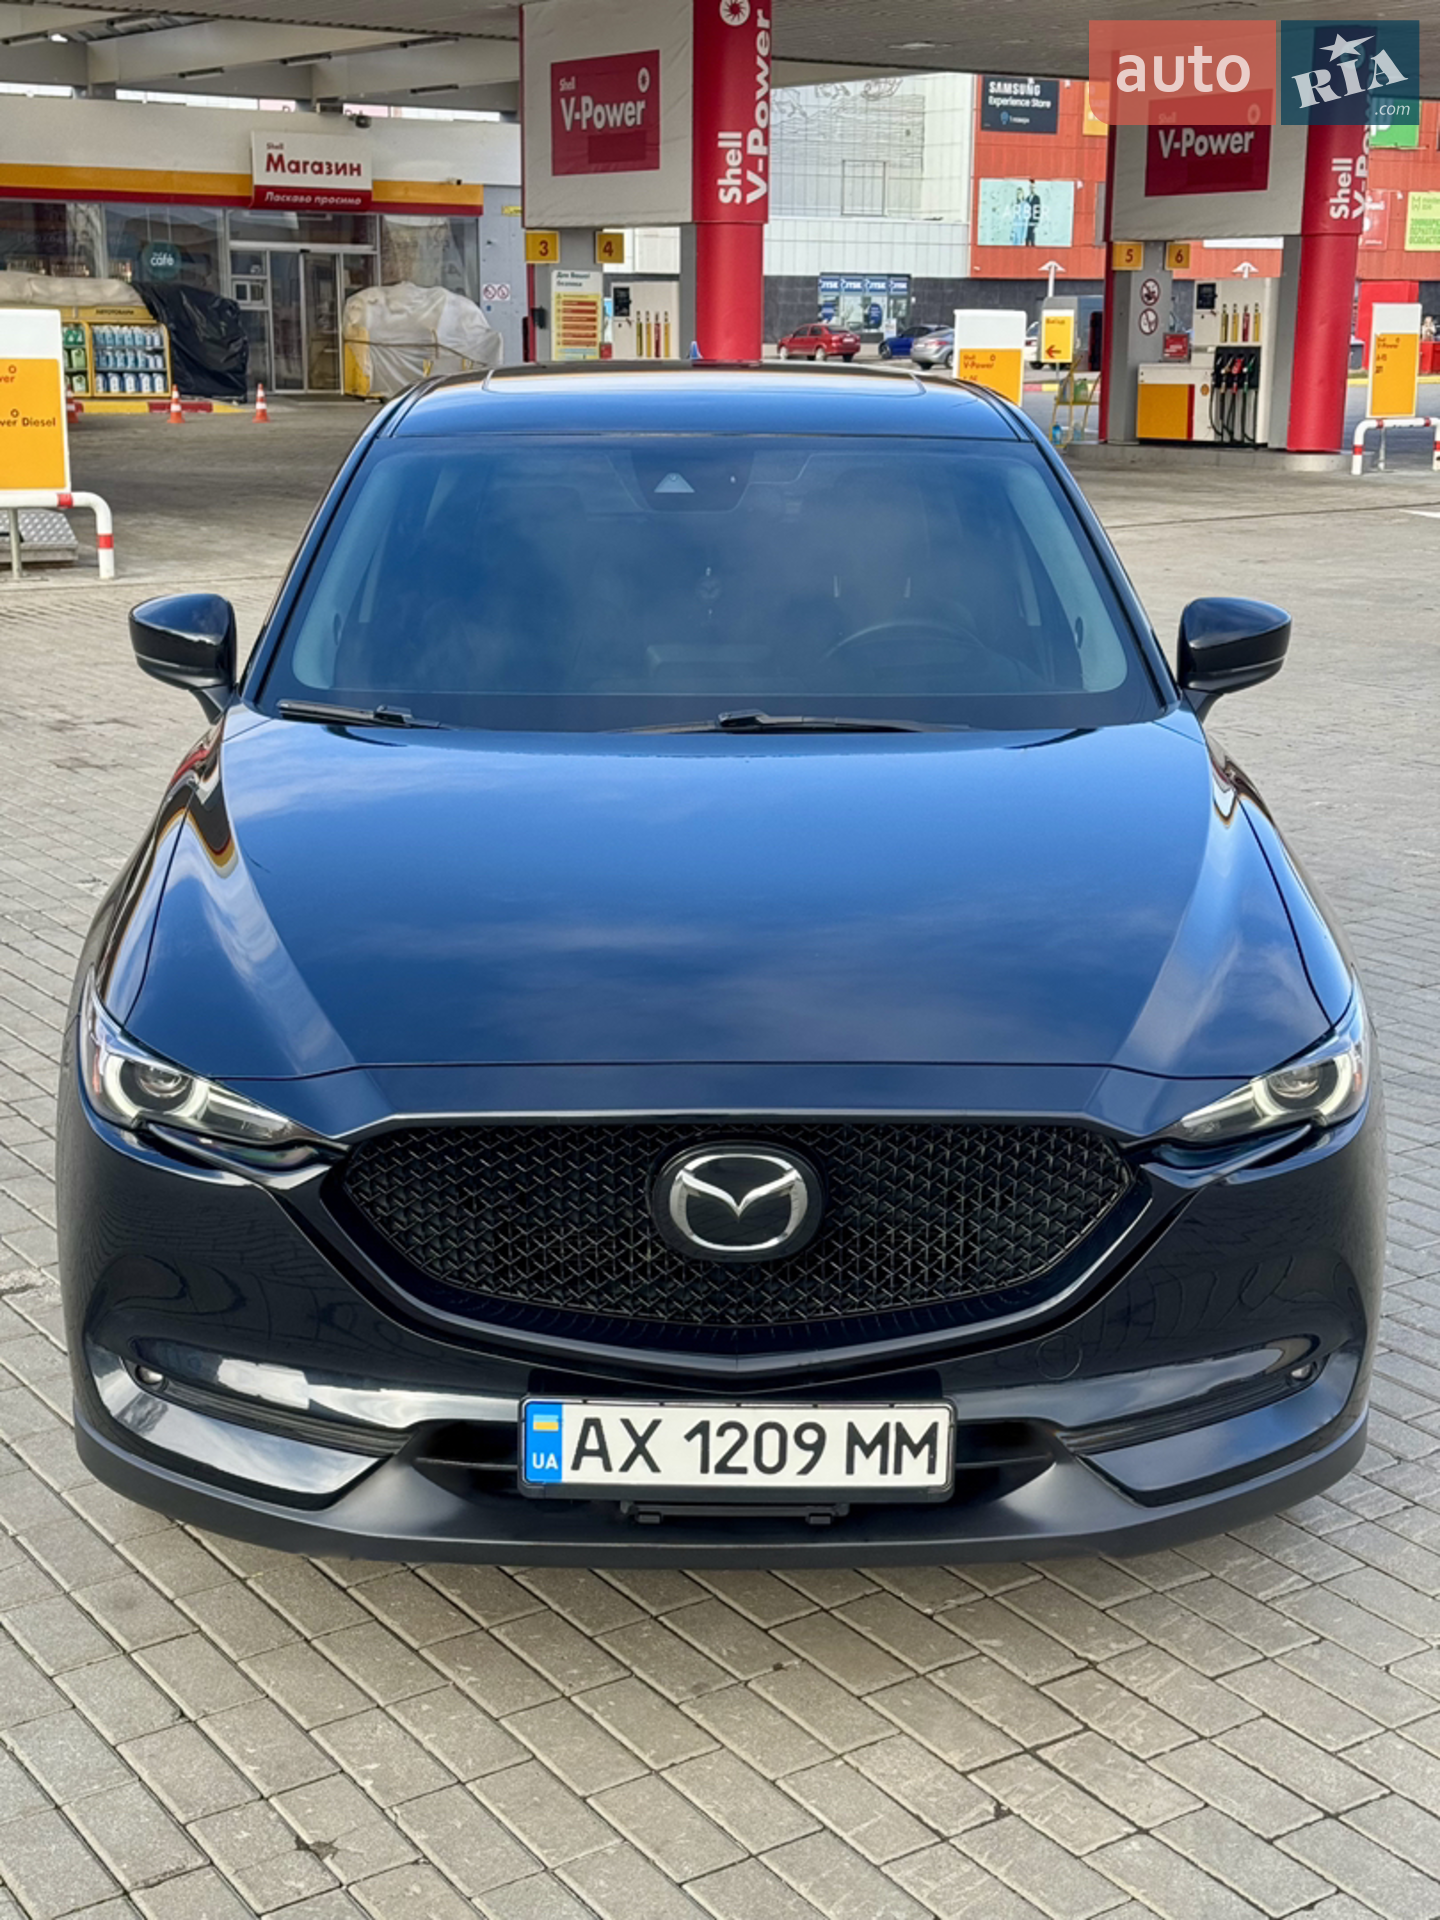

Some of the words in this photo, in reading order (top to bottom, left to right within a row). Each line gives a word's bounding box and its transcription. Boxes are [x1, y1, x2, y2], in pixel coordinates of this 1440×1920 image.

[559, 76, 576, 92] Shell
[988, 81, 1041, 97] SAMSUNG
[746, 9, 771, 204] V-Power
[988, 95, 1031, 108] Experience
[1031, 97, 1052, 109] Store
[560, 95, 646, 132] V-Power
[266, 142, 285, 151] Shell
[1158, 127, 1256, 159] V-Power
[265, 152, 363, 177] Магазин
[717, 131, 743, 205] Shell
[1328, 157, 1353, 220] Shell
[264, 191, 313, 204] Ласкаво
[314, 194, 363, 206] просимо
[1002, 203, 1050, 220] ARBER
[539, 239, 550, 257] 3
[602, 240, 614, 257] 4
[1125, 248, 1134, 264] 5
[1175, 248, 1184, 264] 6
[22, 416, 56, 427] Diesel
[570, 1417, 663, 1474] AX
[683, 1419, 828, 1476] 1209
[845, 1420, 940, 1476] MM
[532, 1452, 559, 1471] UA
